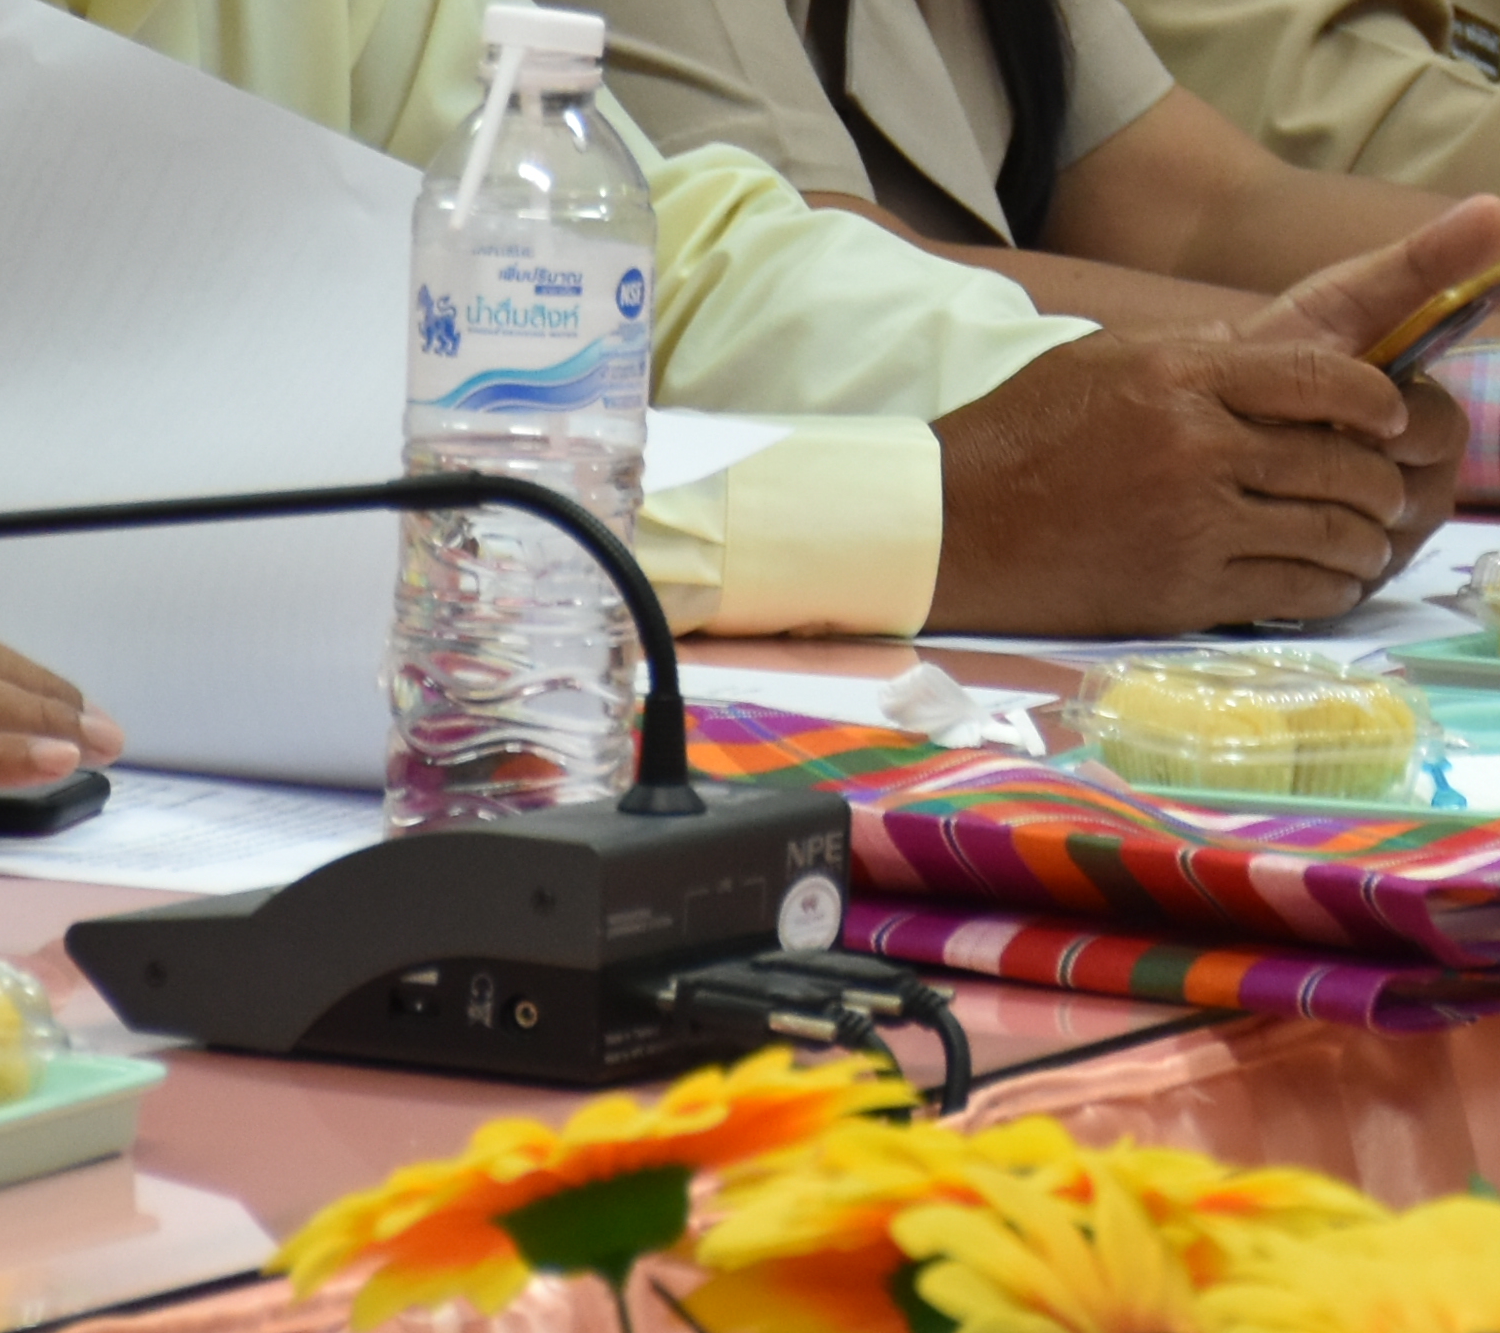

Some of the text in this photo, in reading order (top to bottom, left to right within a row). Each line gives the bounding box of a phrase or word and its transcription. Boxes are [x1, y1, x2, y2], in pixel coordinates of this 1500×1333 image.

[466, 295, 580, 329] น้ำดื่มสิงห์
[786, 831, 842, 867] NPE
